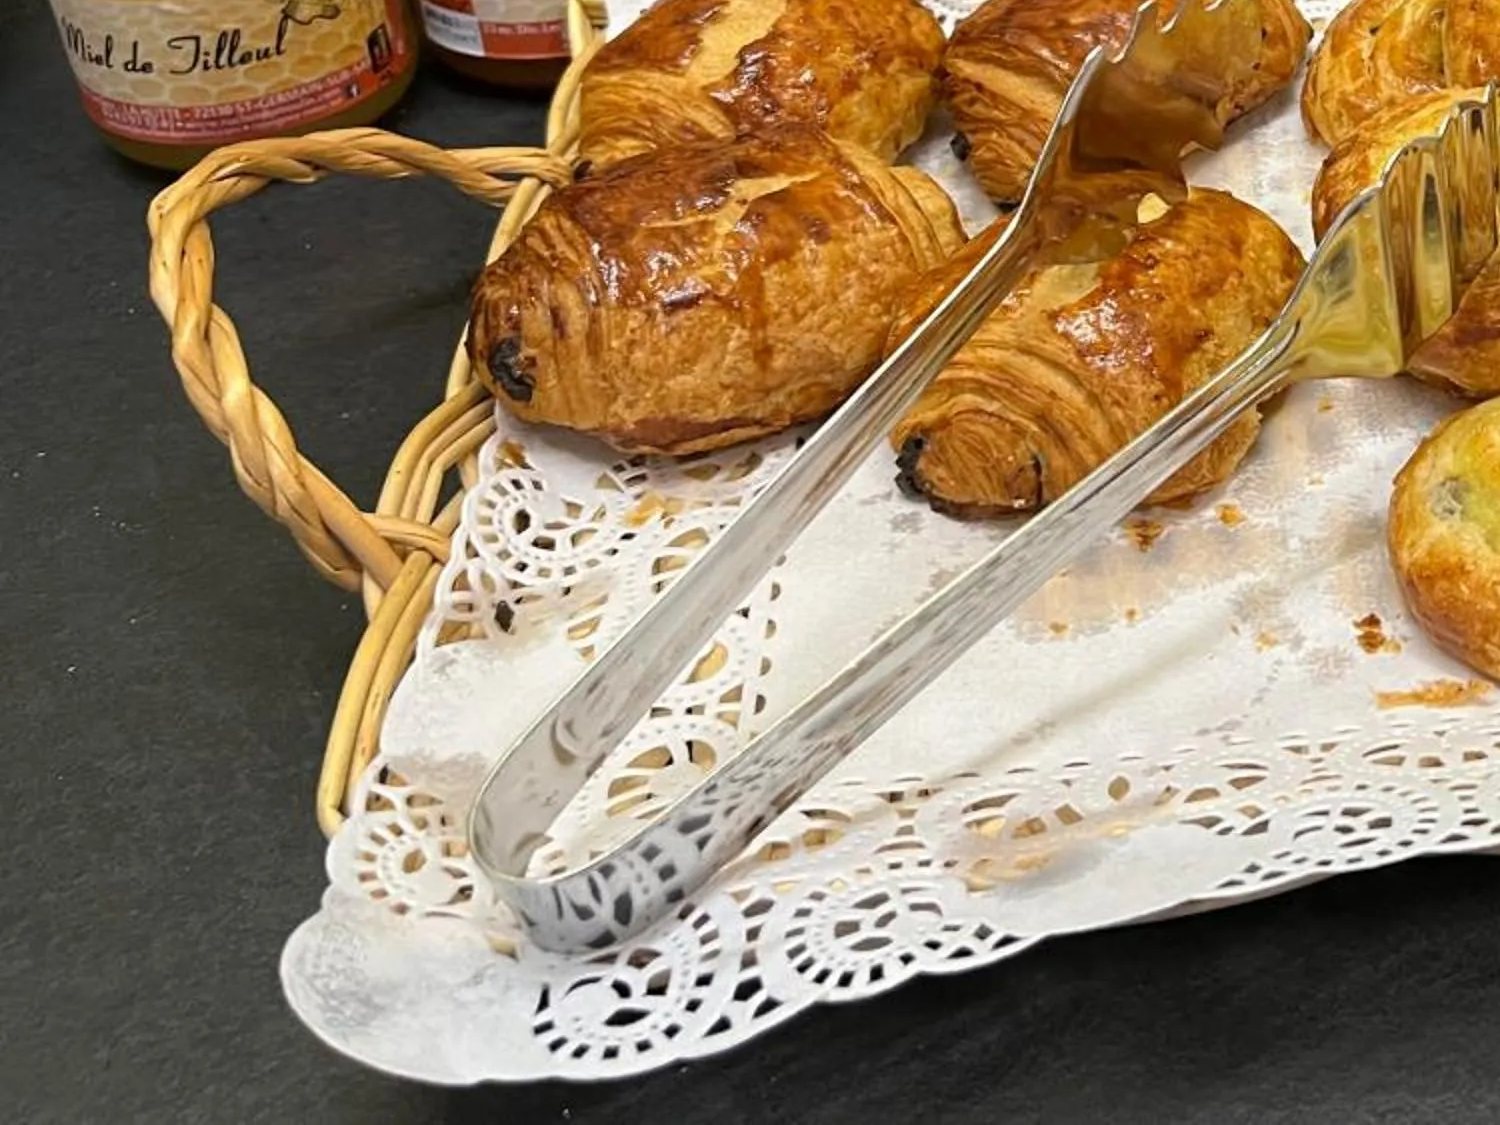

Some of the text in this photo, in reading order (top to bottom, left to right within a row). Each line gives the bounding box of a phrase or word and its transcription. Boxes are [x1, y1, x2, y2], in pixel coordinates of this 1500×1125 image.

[61, 14, 290, 74] Miel de Tilleul
